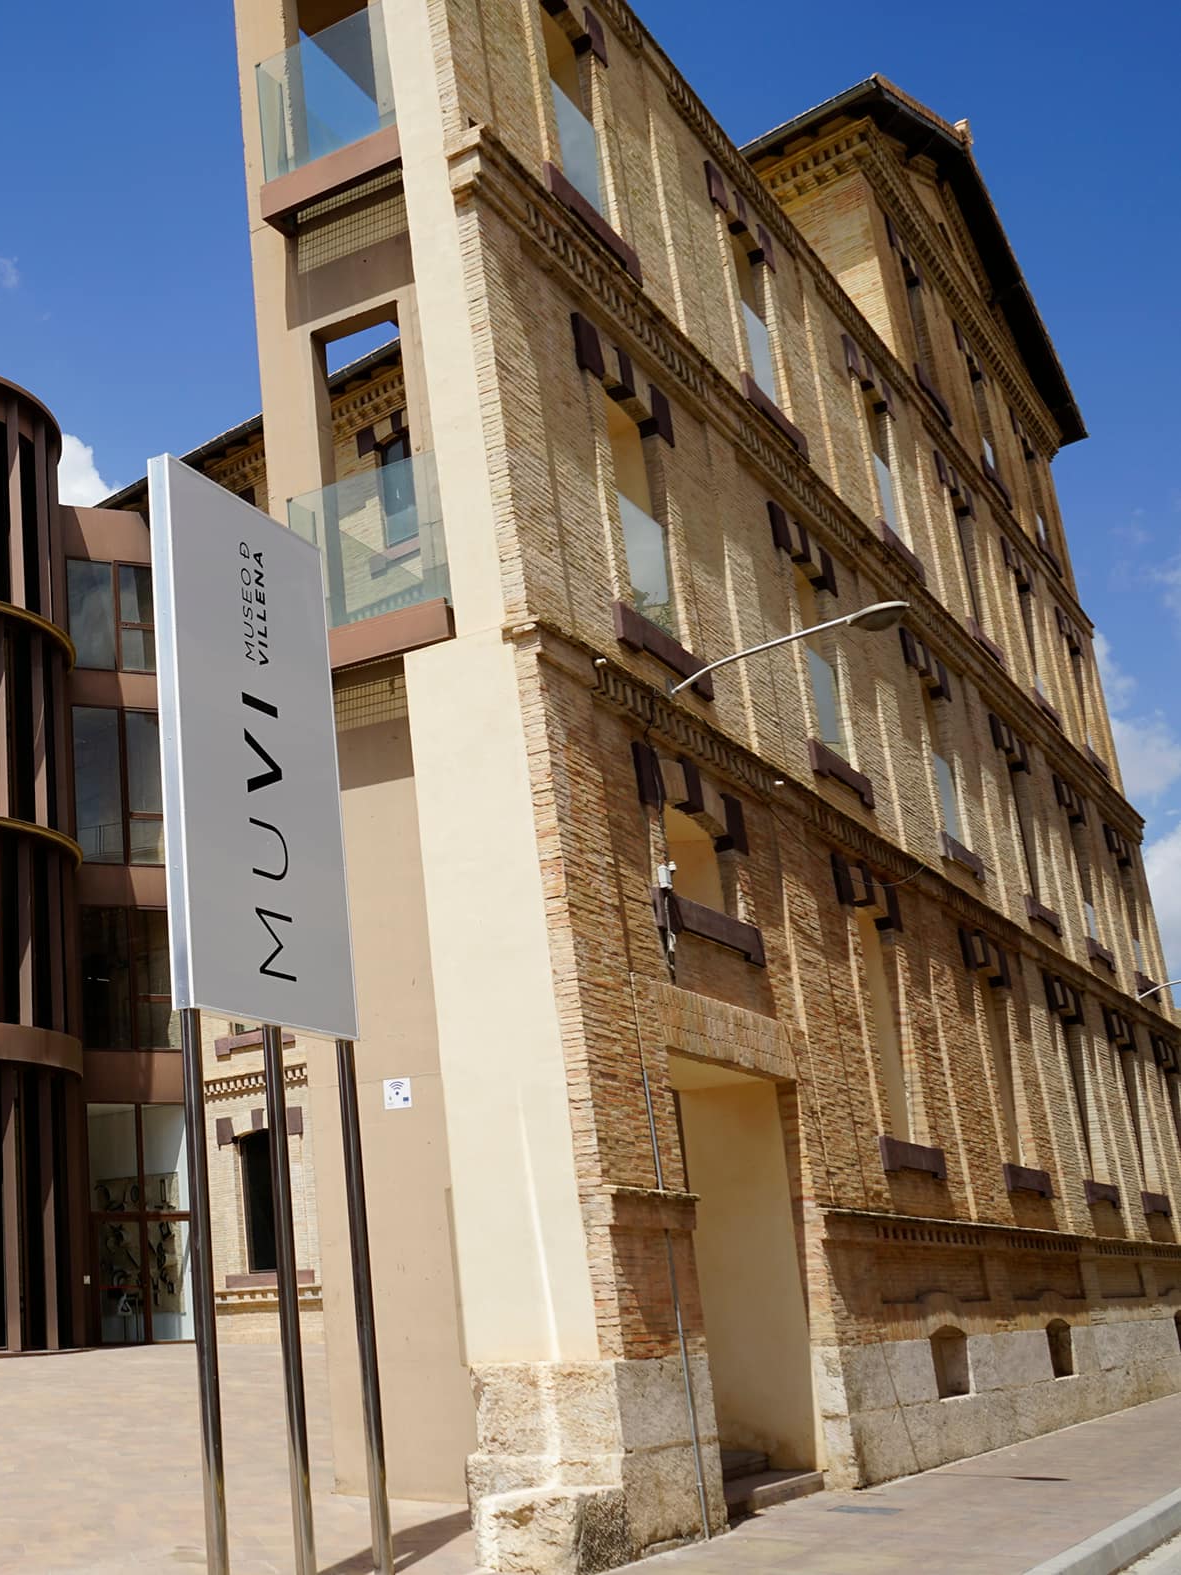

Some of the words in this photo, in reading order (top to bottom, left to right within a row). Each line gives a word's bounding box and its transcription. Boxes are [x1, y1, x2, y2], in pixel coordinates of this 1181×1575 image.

[240, 567, 256, 662] MUSEO
[252, 552, 269, 665] VILLENA
[241, 691, 298, 983] MUVI
